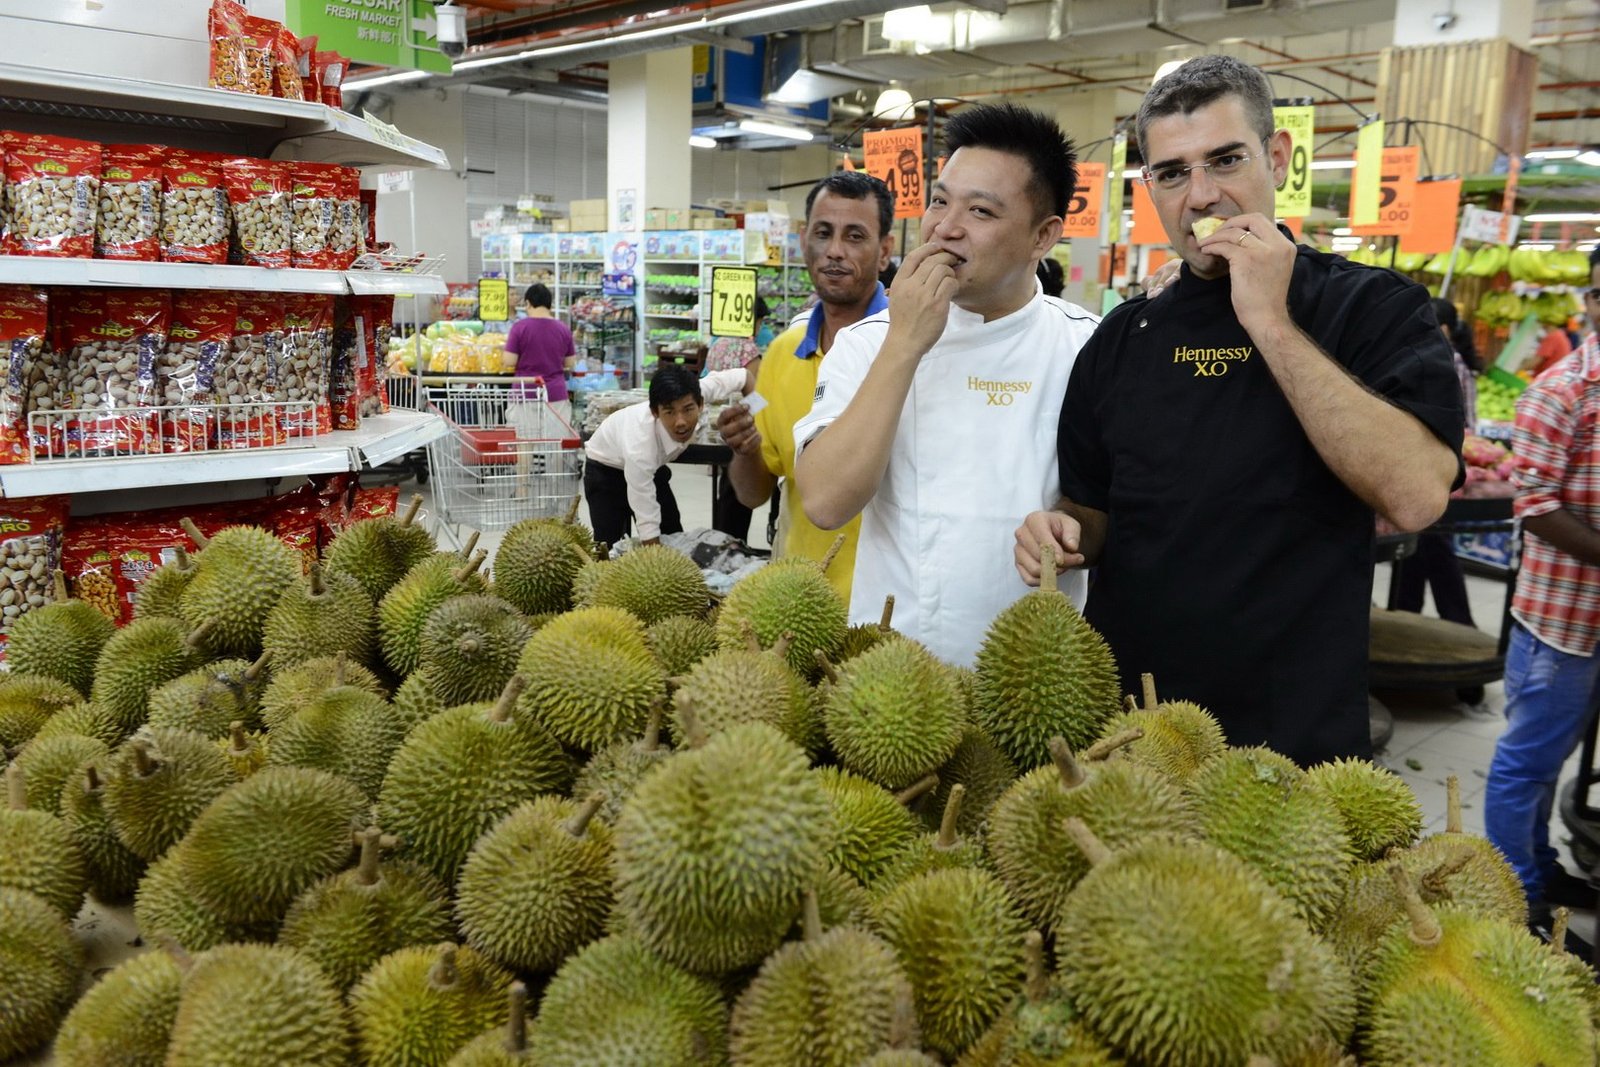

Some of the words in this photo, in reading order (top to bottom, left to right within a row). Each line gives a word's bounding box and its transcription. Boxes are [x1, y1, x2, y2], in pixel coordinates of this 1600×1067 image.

[341, 0, 401, 12] GAR
[324, 3, 359, 20] FRESH
[360, 11, 402, 27] MARKET
[866, 134, 918, 149] PROMOSI
[33, 162, 69, 175] URO
[1276, 145, 1307, 191] 9
[177, 176, 208, 186] URO
[722, 271, 741, 281] GREEN
[719, 292, 754, 323] 7.99
[91, 326, 137, 338] URO
[169, 329, 199, 339] RO
[1172, 346, 1253, 363] Hennessy
[967, 376, 1033, 394] Hennessy
[0, 522, 32, 534] RO
